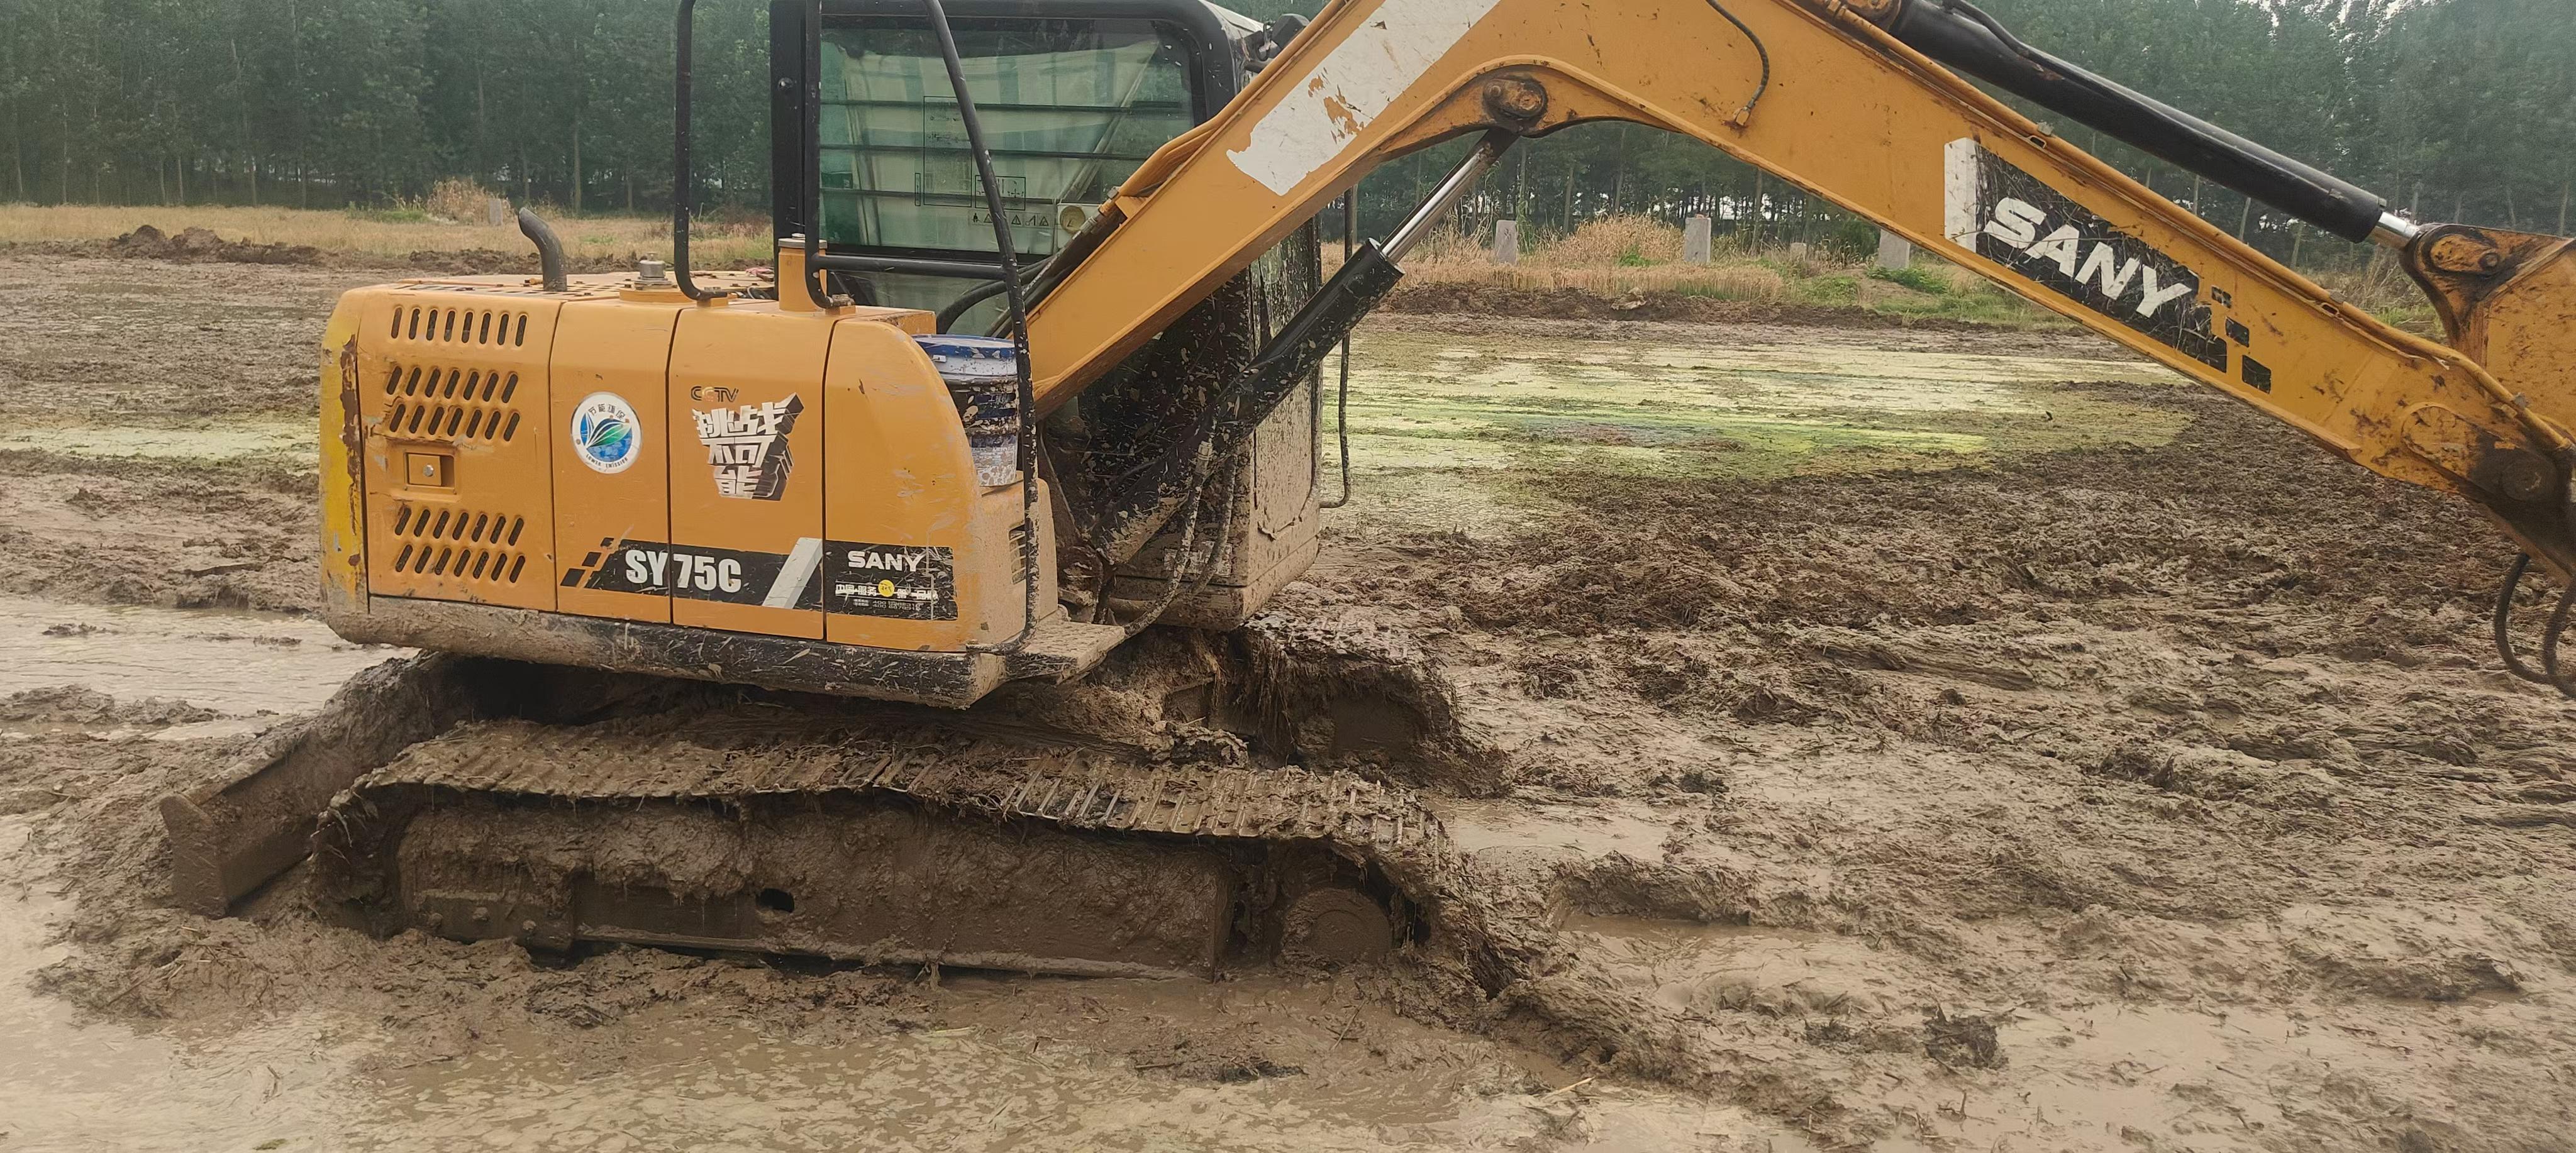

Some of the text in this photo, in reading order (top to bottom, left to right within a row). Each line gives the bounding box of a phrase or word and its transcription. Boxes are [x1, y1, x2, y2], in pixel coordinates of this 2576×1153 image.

[1983, 197, 2192, 318] SANY
[691, 386, 739, 402] CCTV
[692, 393, 799, 438] 挑战
[699, 434, 778, 468] 不可
[713, 465, 763, 500] 能
[625, 549, 741, 593] SY75C
[847, 550, 927, 572] SANY
